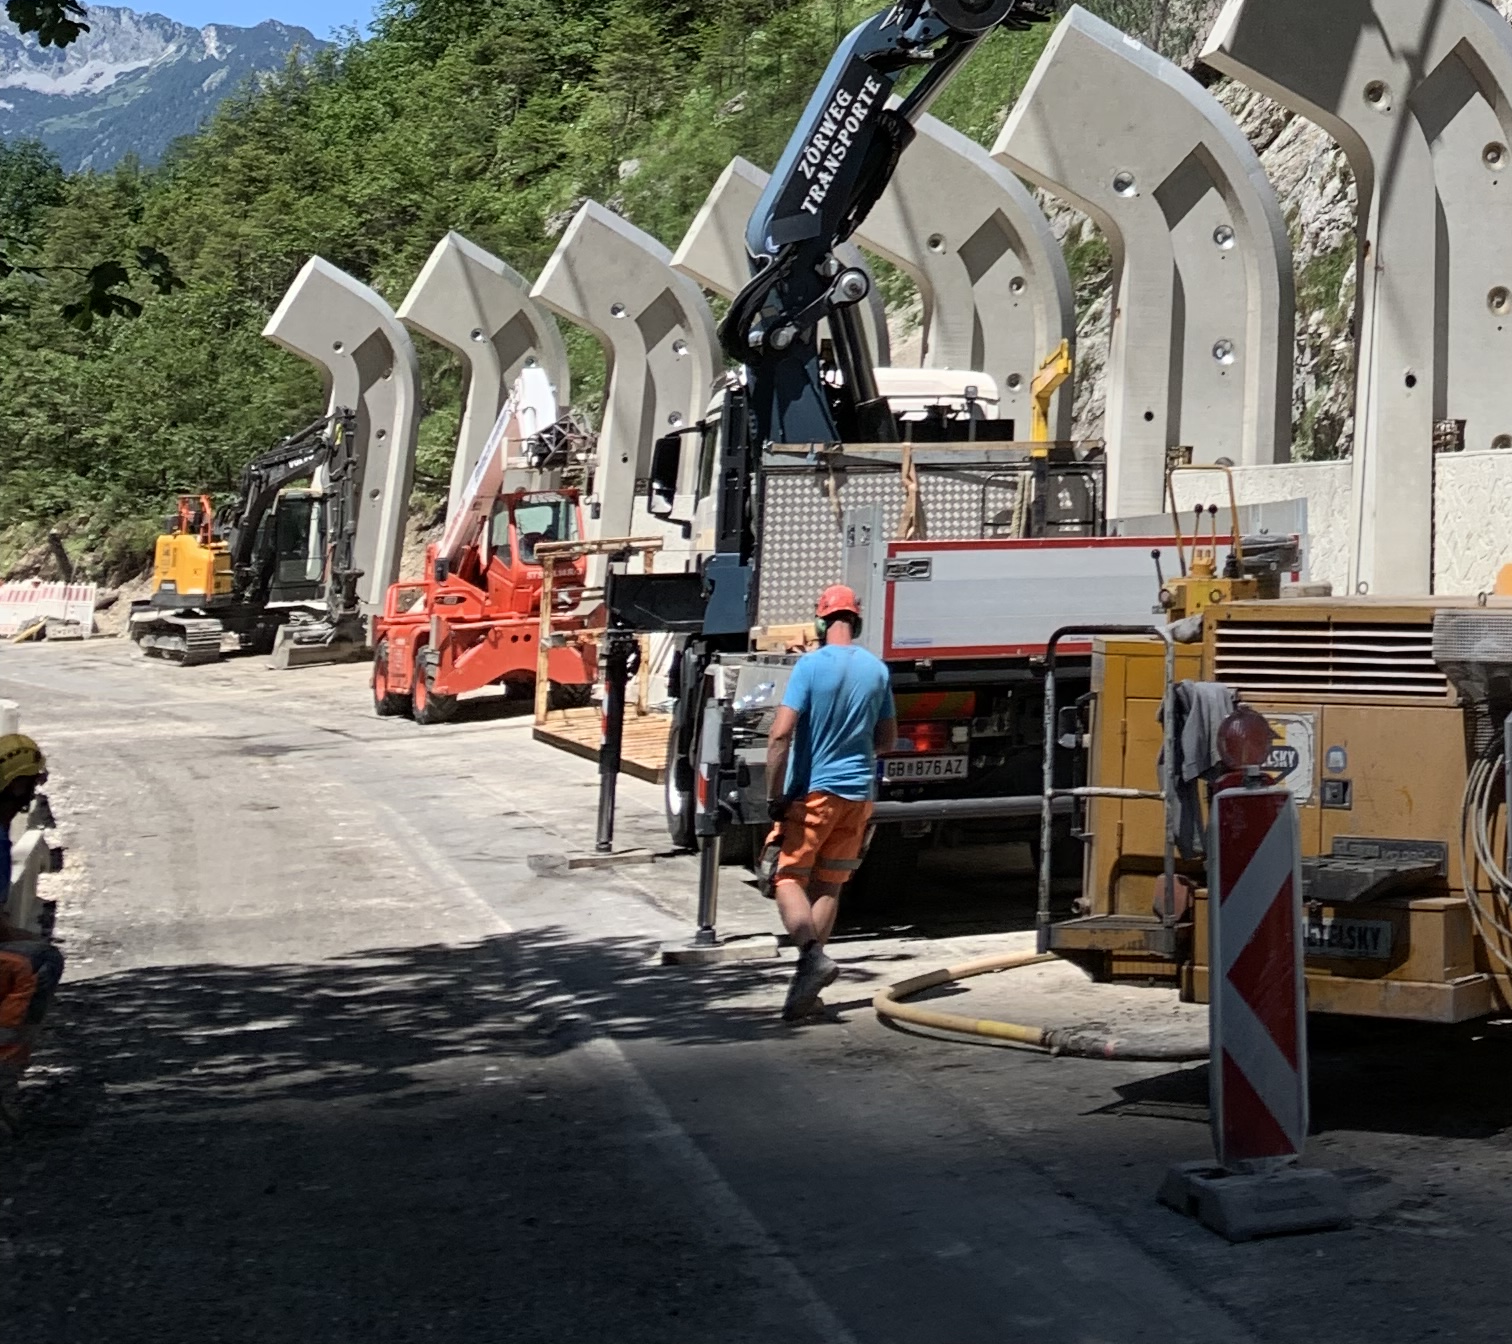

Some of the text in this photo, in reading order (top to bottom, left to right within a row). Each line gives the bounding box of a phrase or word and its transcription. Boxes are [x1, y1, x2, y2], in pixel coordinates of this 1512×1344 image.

[797, 88, 853, 180] ZÖRWEG
[800, 74, 882, 215] TRANSPORTE
[887, 759, 963, 777] GB 876 AZ
